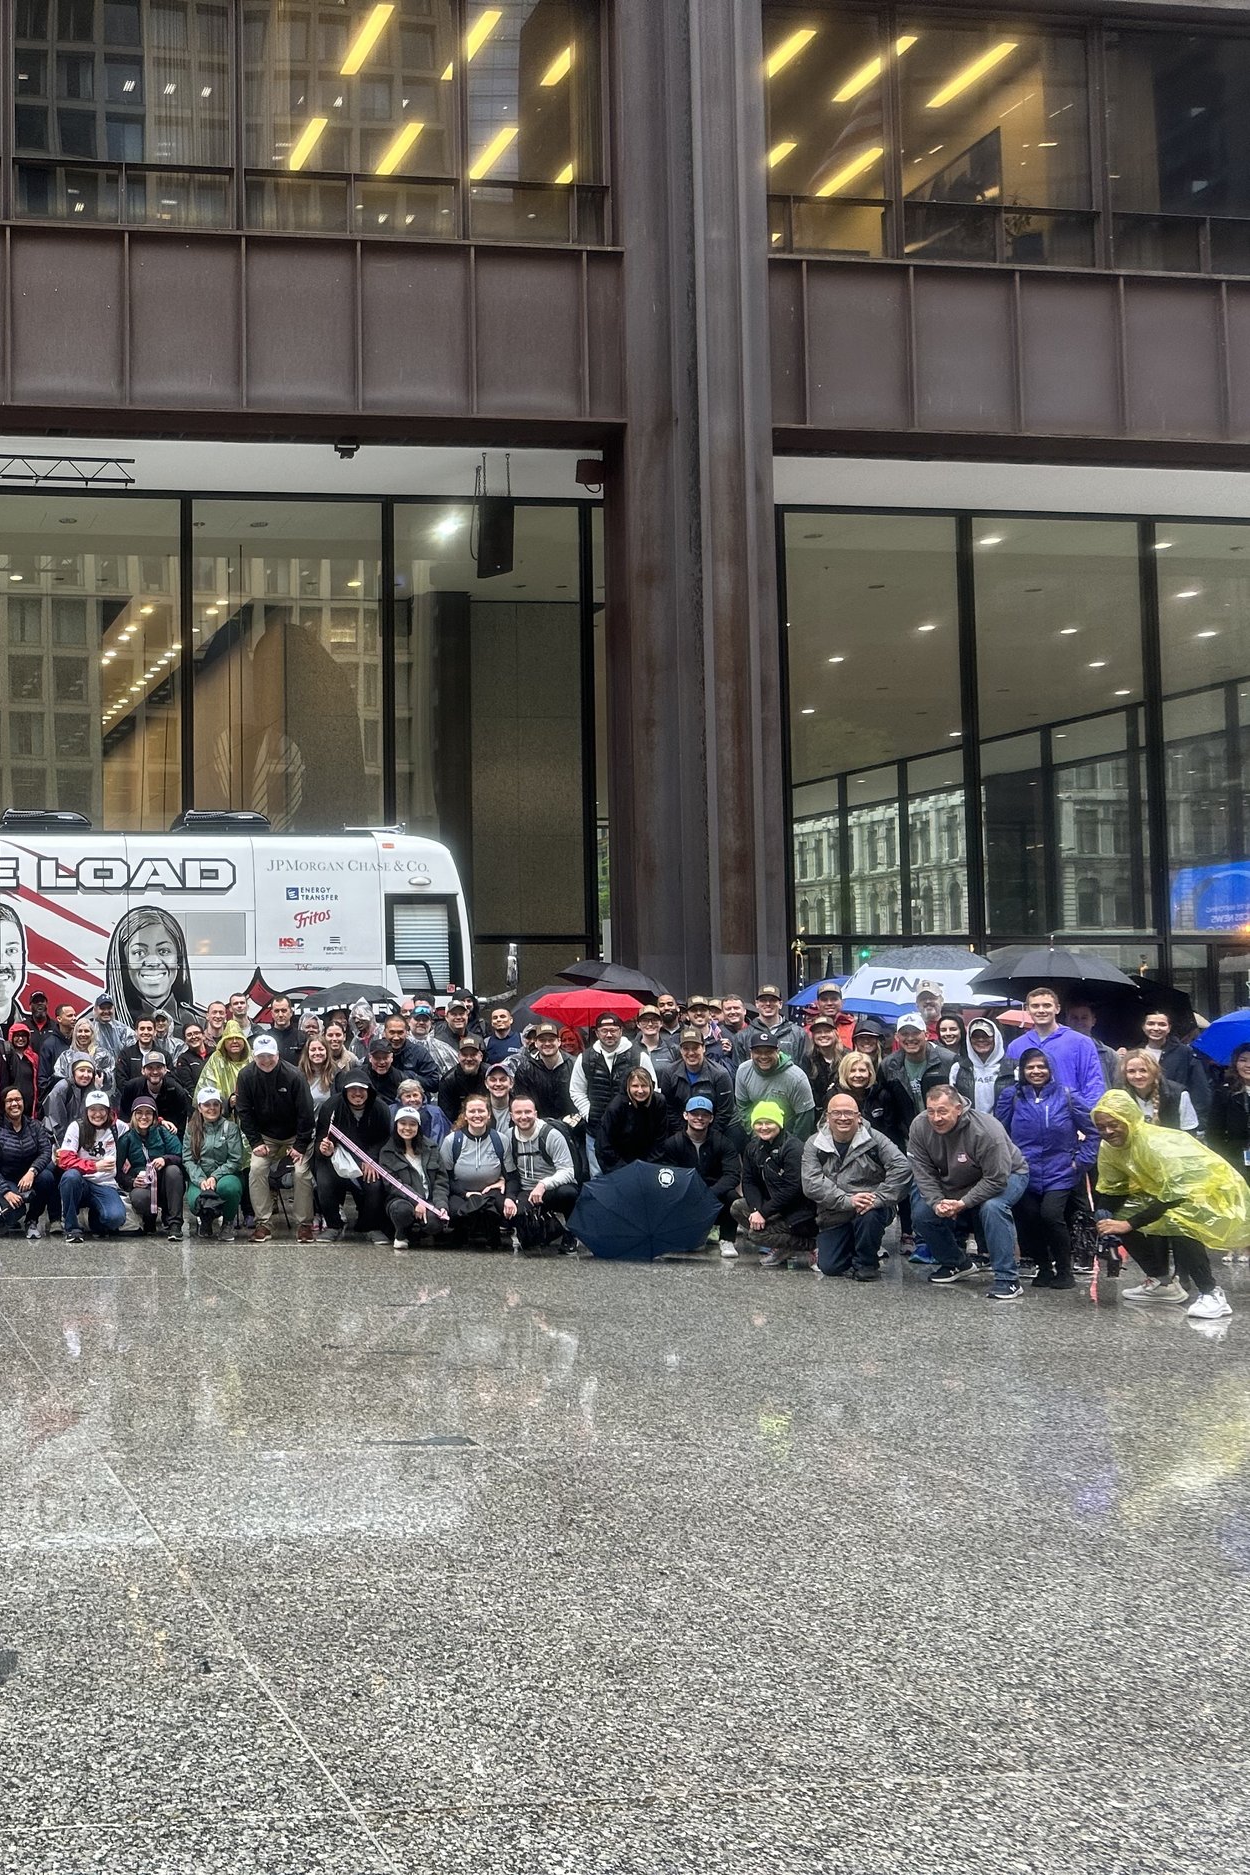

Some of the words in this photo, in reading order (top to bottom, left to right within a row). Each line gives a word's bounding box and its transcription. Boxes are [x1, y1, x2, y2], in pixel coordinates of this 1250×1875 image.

[39, 857, 236, 890] LOAD
[393, 861, 404, 872] &
[293, 909, 331, 929] Fritos
[870, 976, 944, 995] PIN
